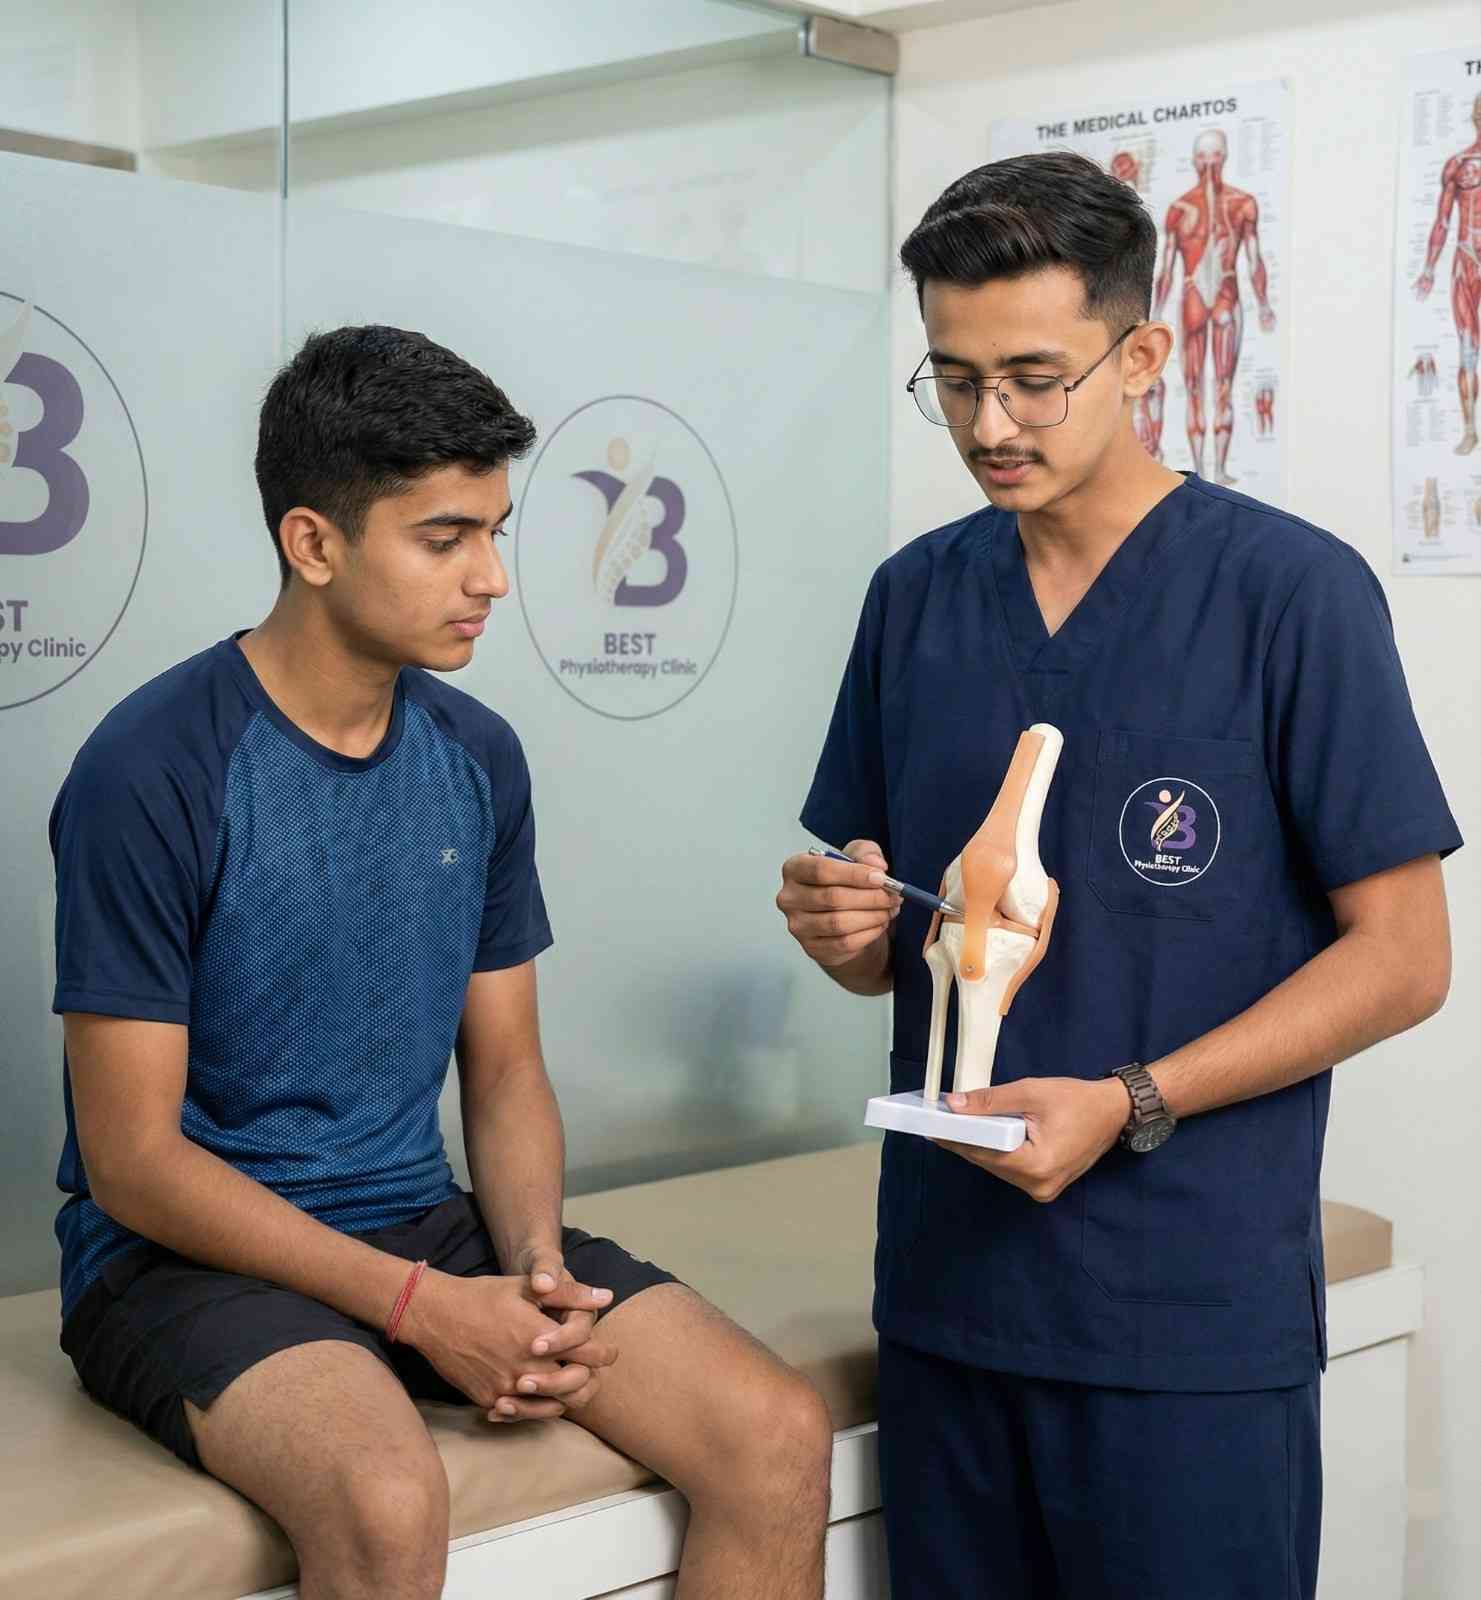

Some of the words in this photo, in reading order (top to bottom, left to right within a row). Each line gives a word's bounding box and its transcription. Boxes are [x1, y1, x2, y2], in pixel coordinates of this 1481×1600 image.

[1036, 122, 1068, 140] THE
[1073, 111, 1148, 135] MEDICAL
[1153, 98, 1238, 123] CHARTOS
[0, 600, 28, 633] T
[28, 637, 86, 657] Clinic
[604, 633, 657, 656] BEST
[560, 658, 658, 679] Physiotherapy
[661, 658, 697, 675] Clinic
[1155, 854, 1183, 865] BEST
